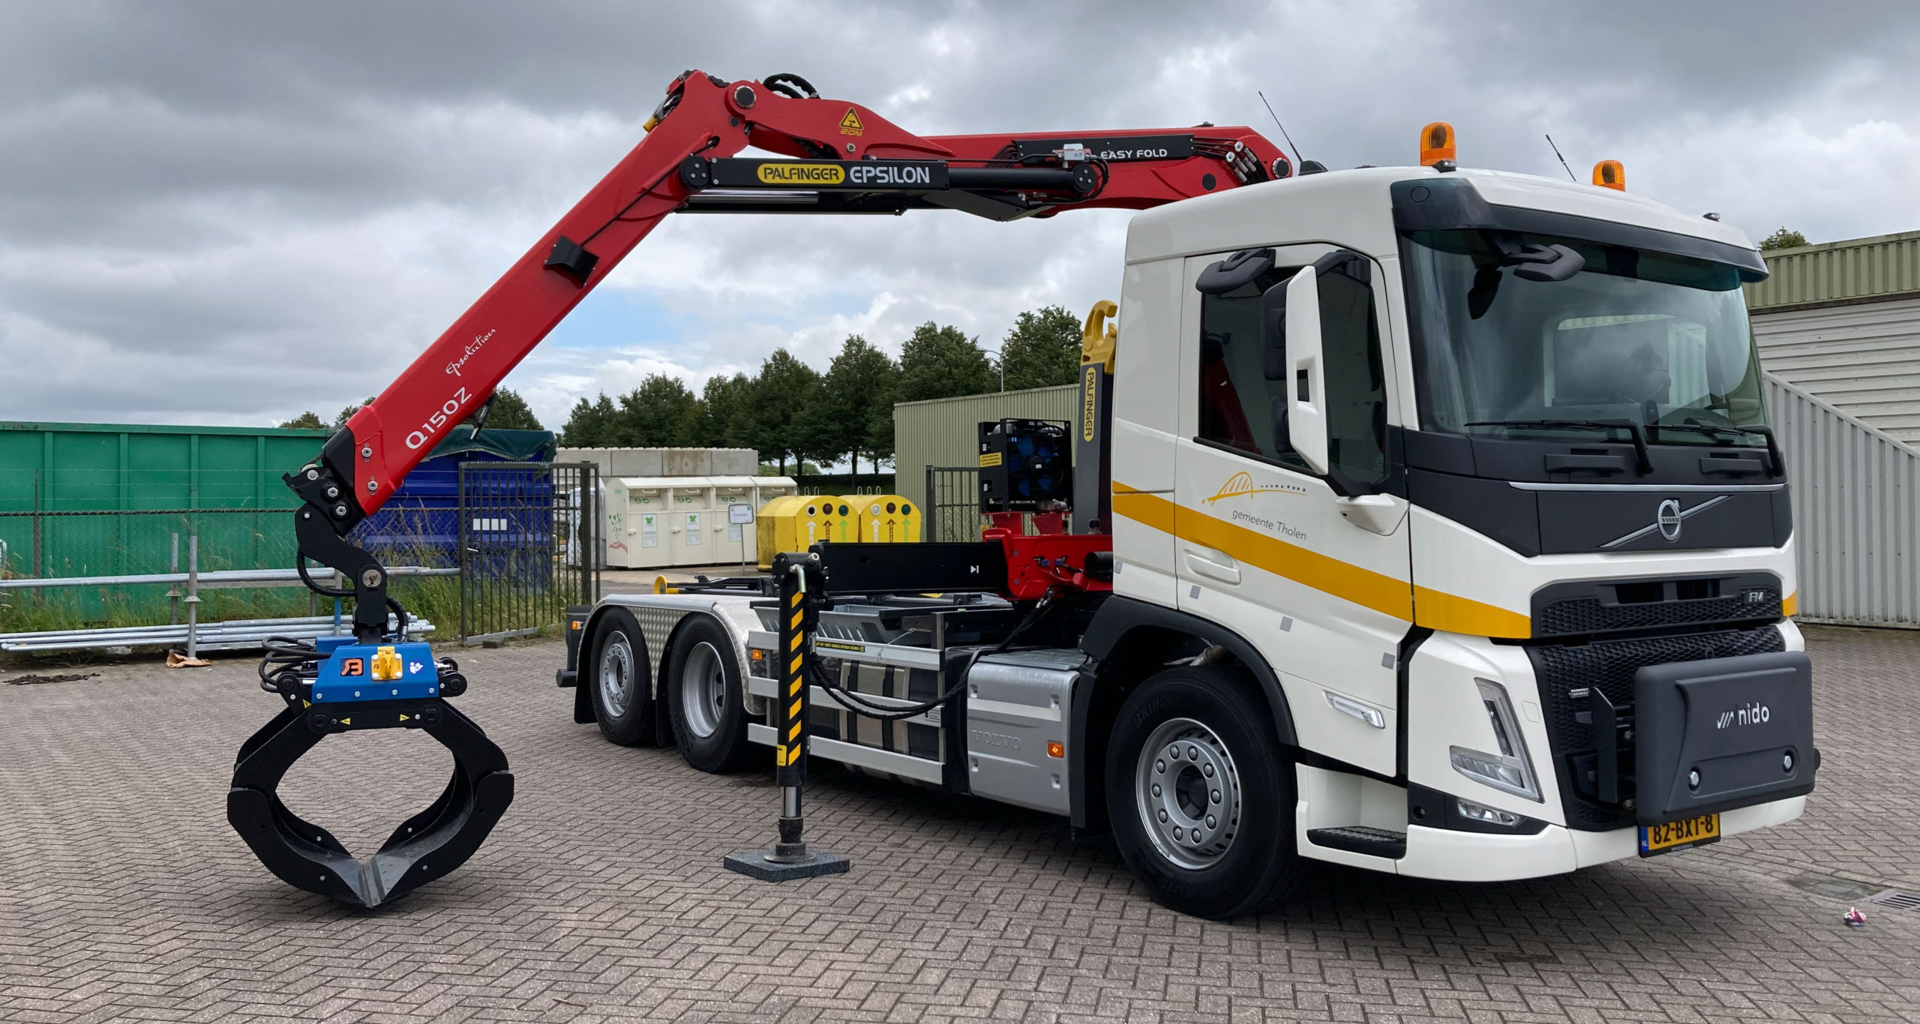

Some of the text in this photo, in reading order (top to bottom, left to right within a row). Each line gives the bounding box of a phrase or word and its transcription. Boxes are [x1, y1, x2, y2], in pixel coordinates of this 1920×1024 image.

[840, 129, 863, 137] 20M
[1100, 149, 1168, 159] EASY FOLD
[763, 166, 930, 184] PALFINGER EPSILON
[445, 328, 497, 377] Epsolution
[405, 386, 472, 449] Q150Z
[1085, 372, 1095, 437] PALFINGER
[1232, 510, 1307, 541] gemeente Tholen
[1738, 702, 1770, 726] nido
[971, 729, 1021, 750] VOLVO
[1653, 815, 1714, 844] 82-BXT-8
